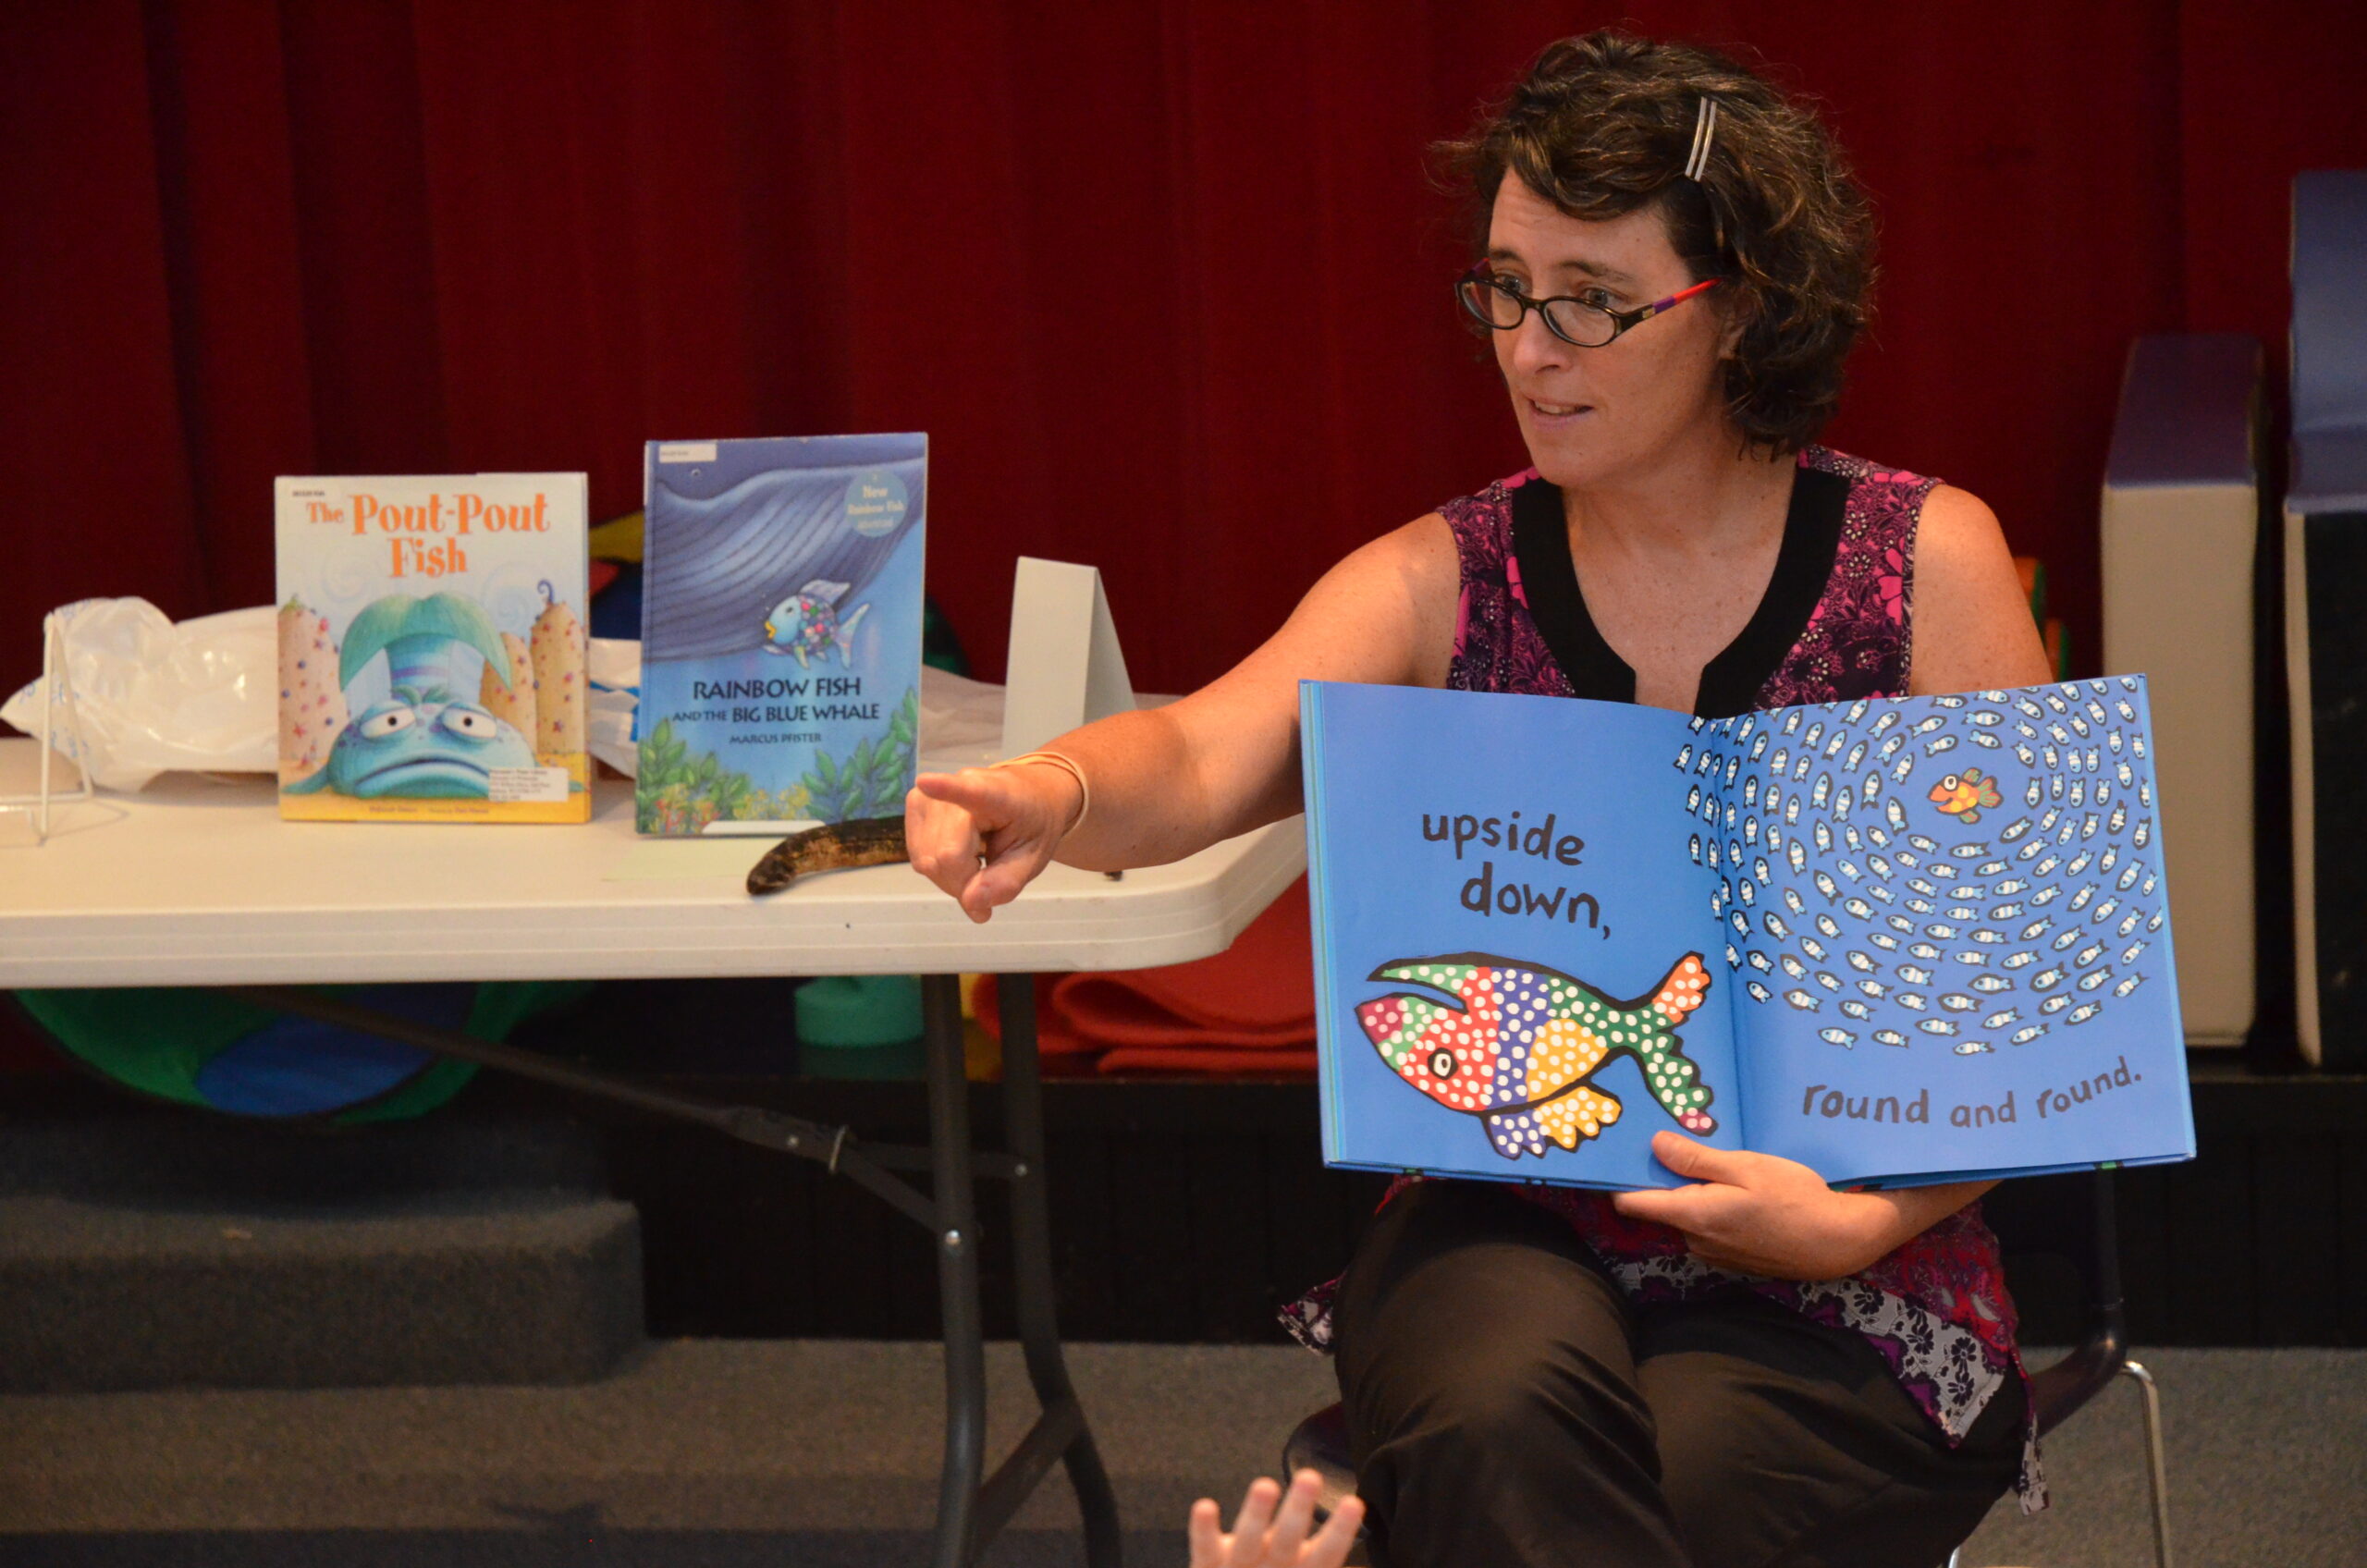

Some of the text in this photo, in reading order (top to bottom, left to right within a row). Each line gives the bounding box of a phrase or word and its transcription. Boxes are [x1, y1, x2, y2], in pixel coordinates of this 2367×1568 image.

[306, 493, 551, 534] The Pout-Pout
[386, 536, 467, 578] Fish
[693, 678, 861, 699] RAINBOW FISH
[673, 704, 880, 722] AND THE BIG BLUE WHALE
[730, 733, 821, 743] MARCUS PFISTER
[1422, 811, 1585, 866] upside
[1460, 861, 1612, 940] down,
[1802, 1055, 2142, 1129] round and round.
